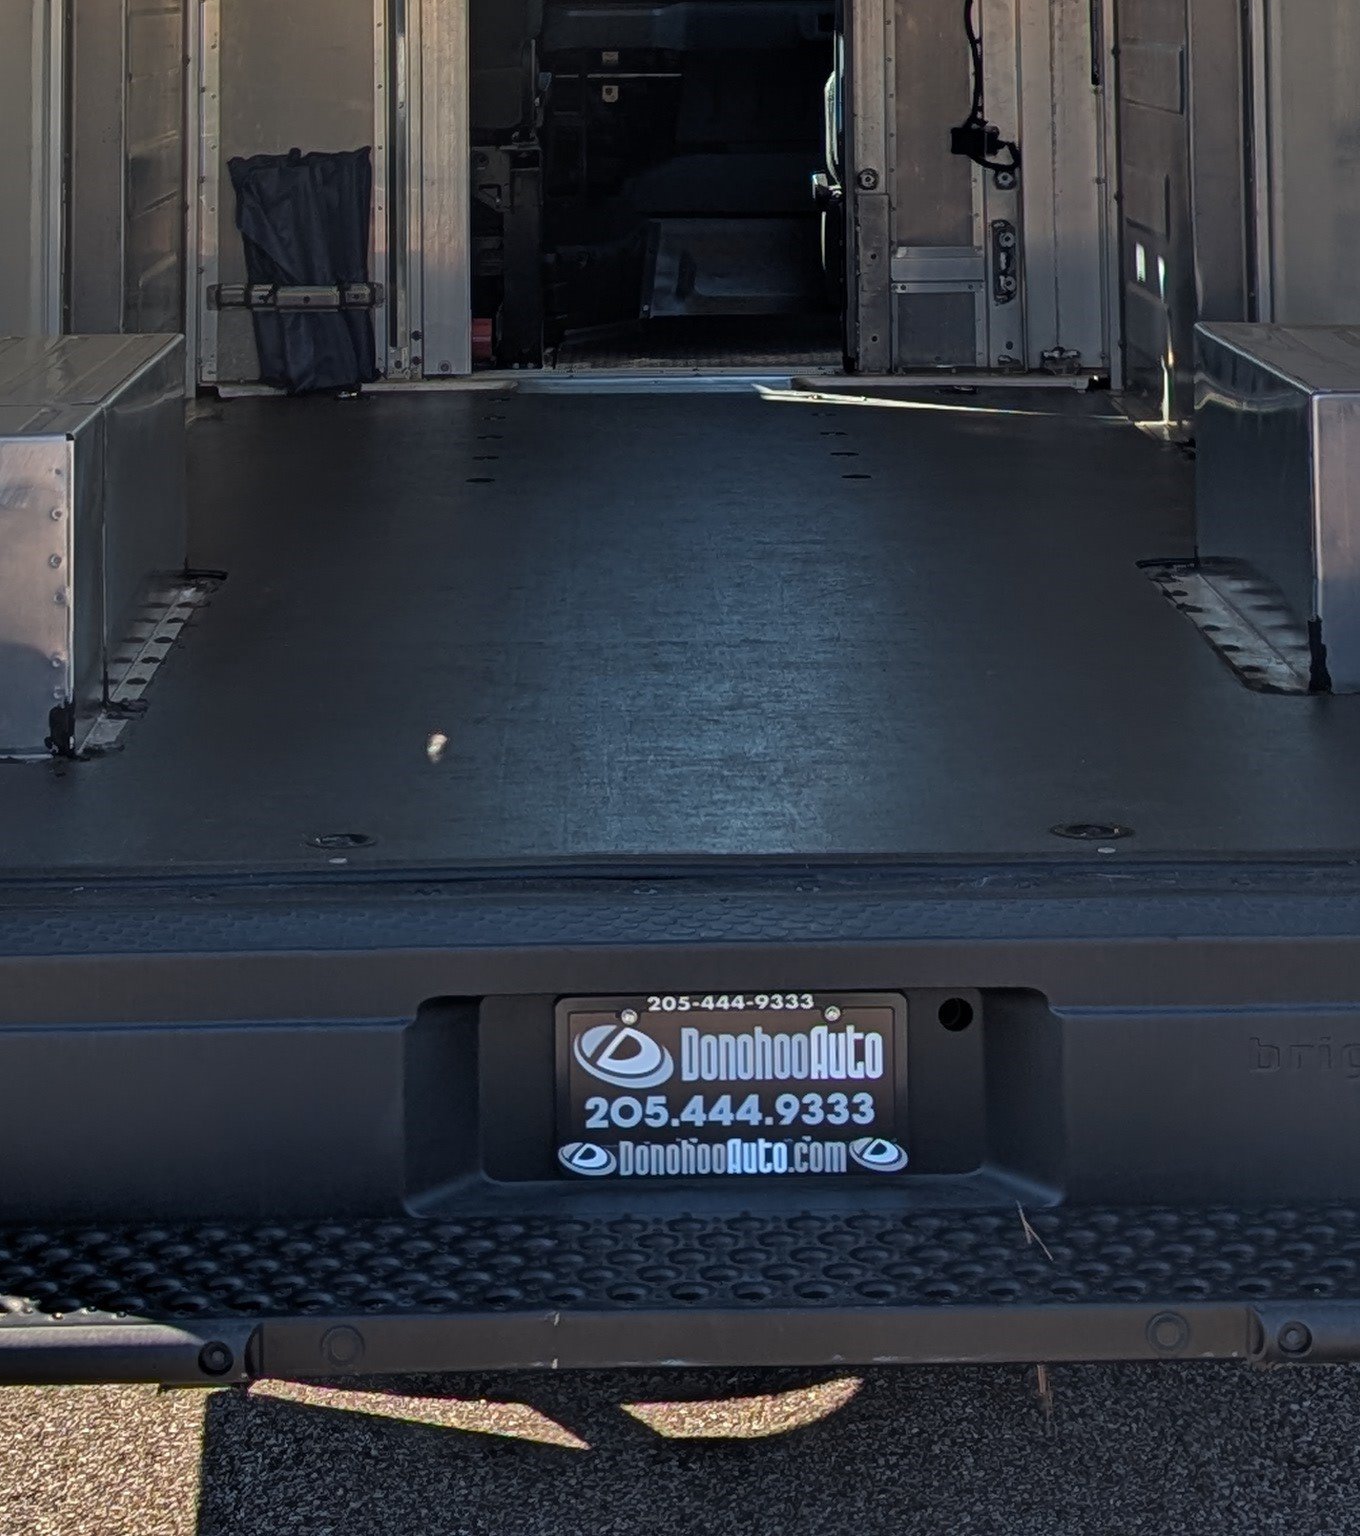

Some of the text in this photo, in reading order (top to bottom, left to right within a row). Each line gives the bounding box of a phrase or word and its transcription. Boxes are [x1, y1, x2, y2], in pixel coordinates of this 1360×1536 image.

[647, 994, 815, 1012] 205-444-9333
[680, 1025, 884, 1081] DonohooAuto
[584, 1092, 876, 1129] 205.444.9333
[619, 1136, 847, 1176] DonohooAuto.com
